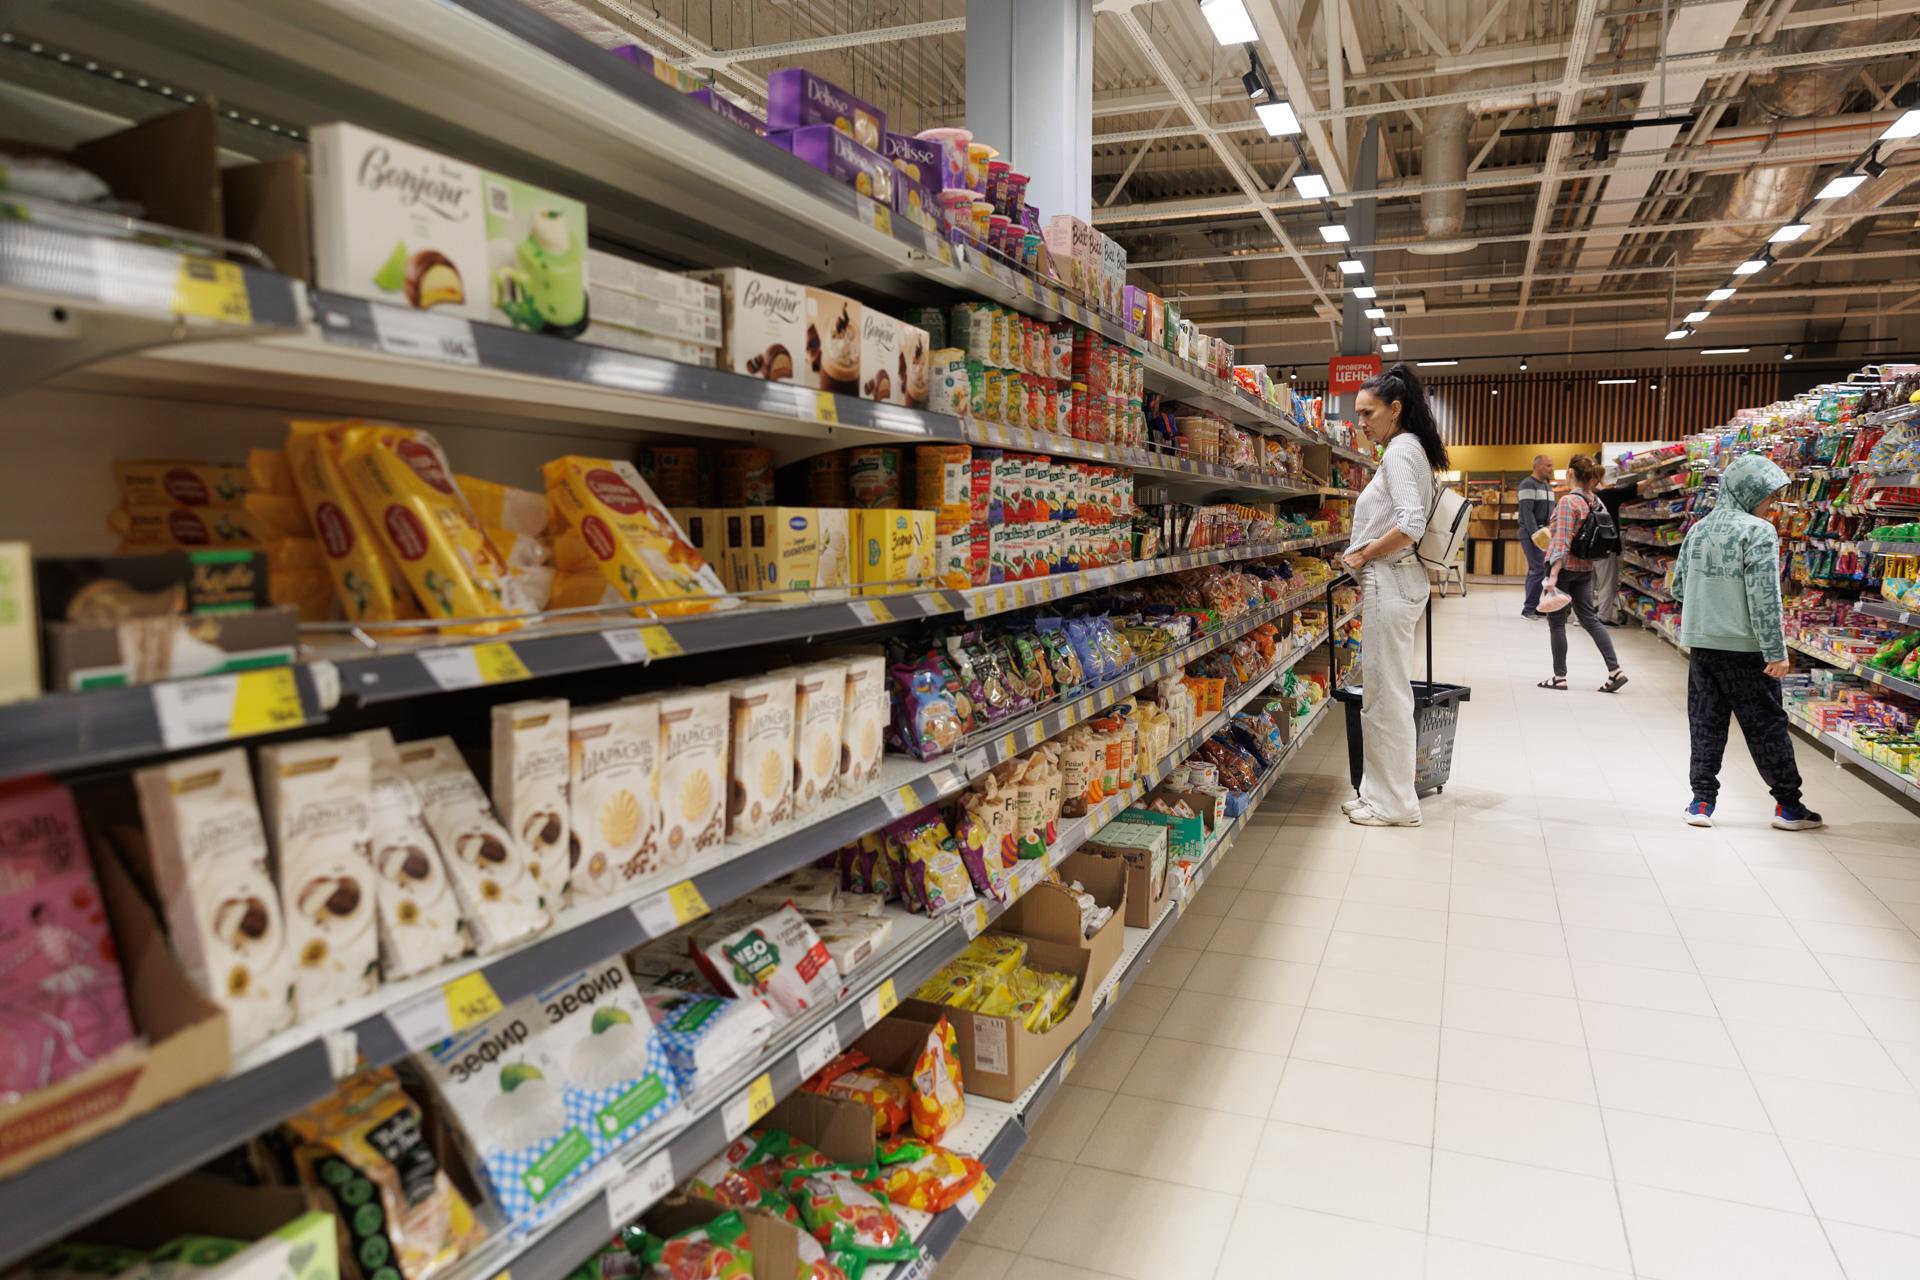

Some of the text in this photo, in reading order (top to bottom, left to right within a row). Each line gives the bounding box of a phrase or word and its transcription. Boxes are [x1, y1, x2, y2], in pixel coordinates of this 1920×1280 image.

[357, 146, 473, 223] Bonjour
[743, 279, 800, 325] Bonjour
[1335, 370, 1373, 383] ЦЕНЫ
[1336, 363, 1373, 371] ПРОВЕРКА
[733, 939, 768, 966] NEO
[544, 964, 624, 1026] зефир
[450, 1018, 529, 1084] зефир
